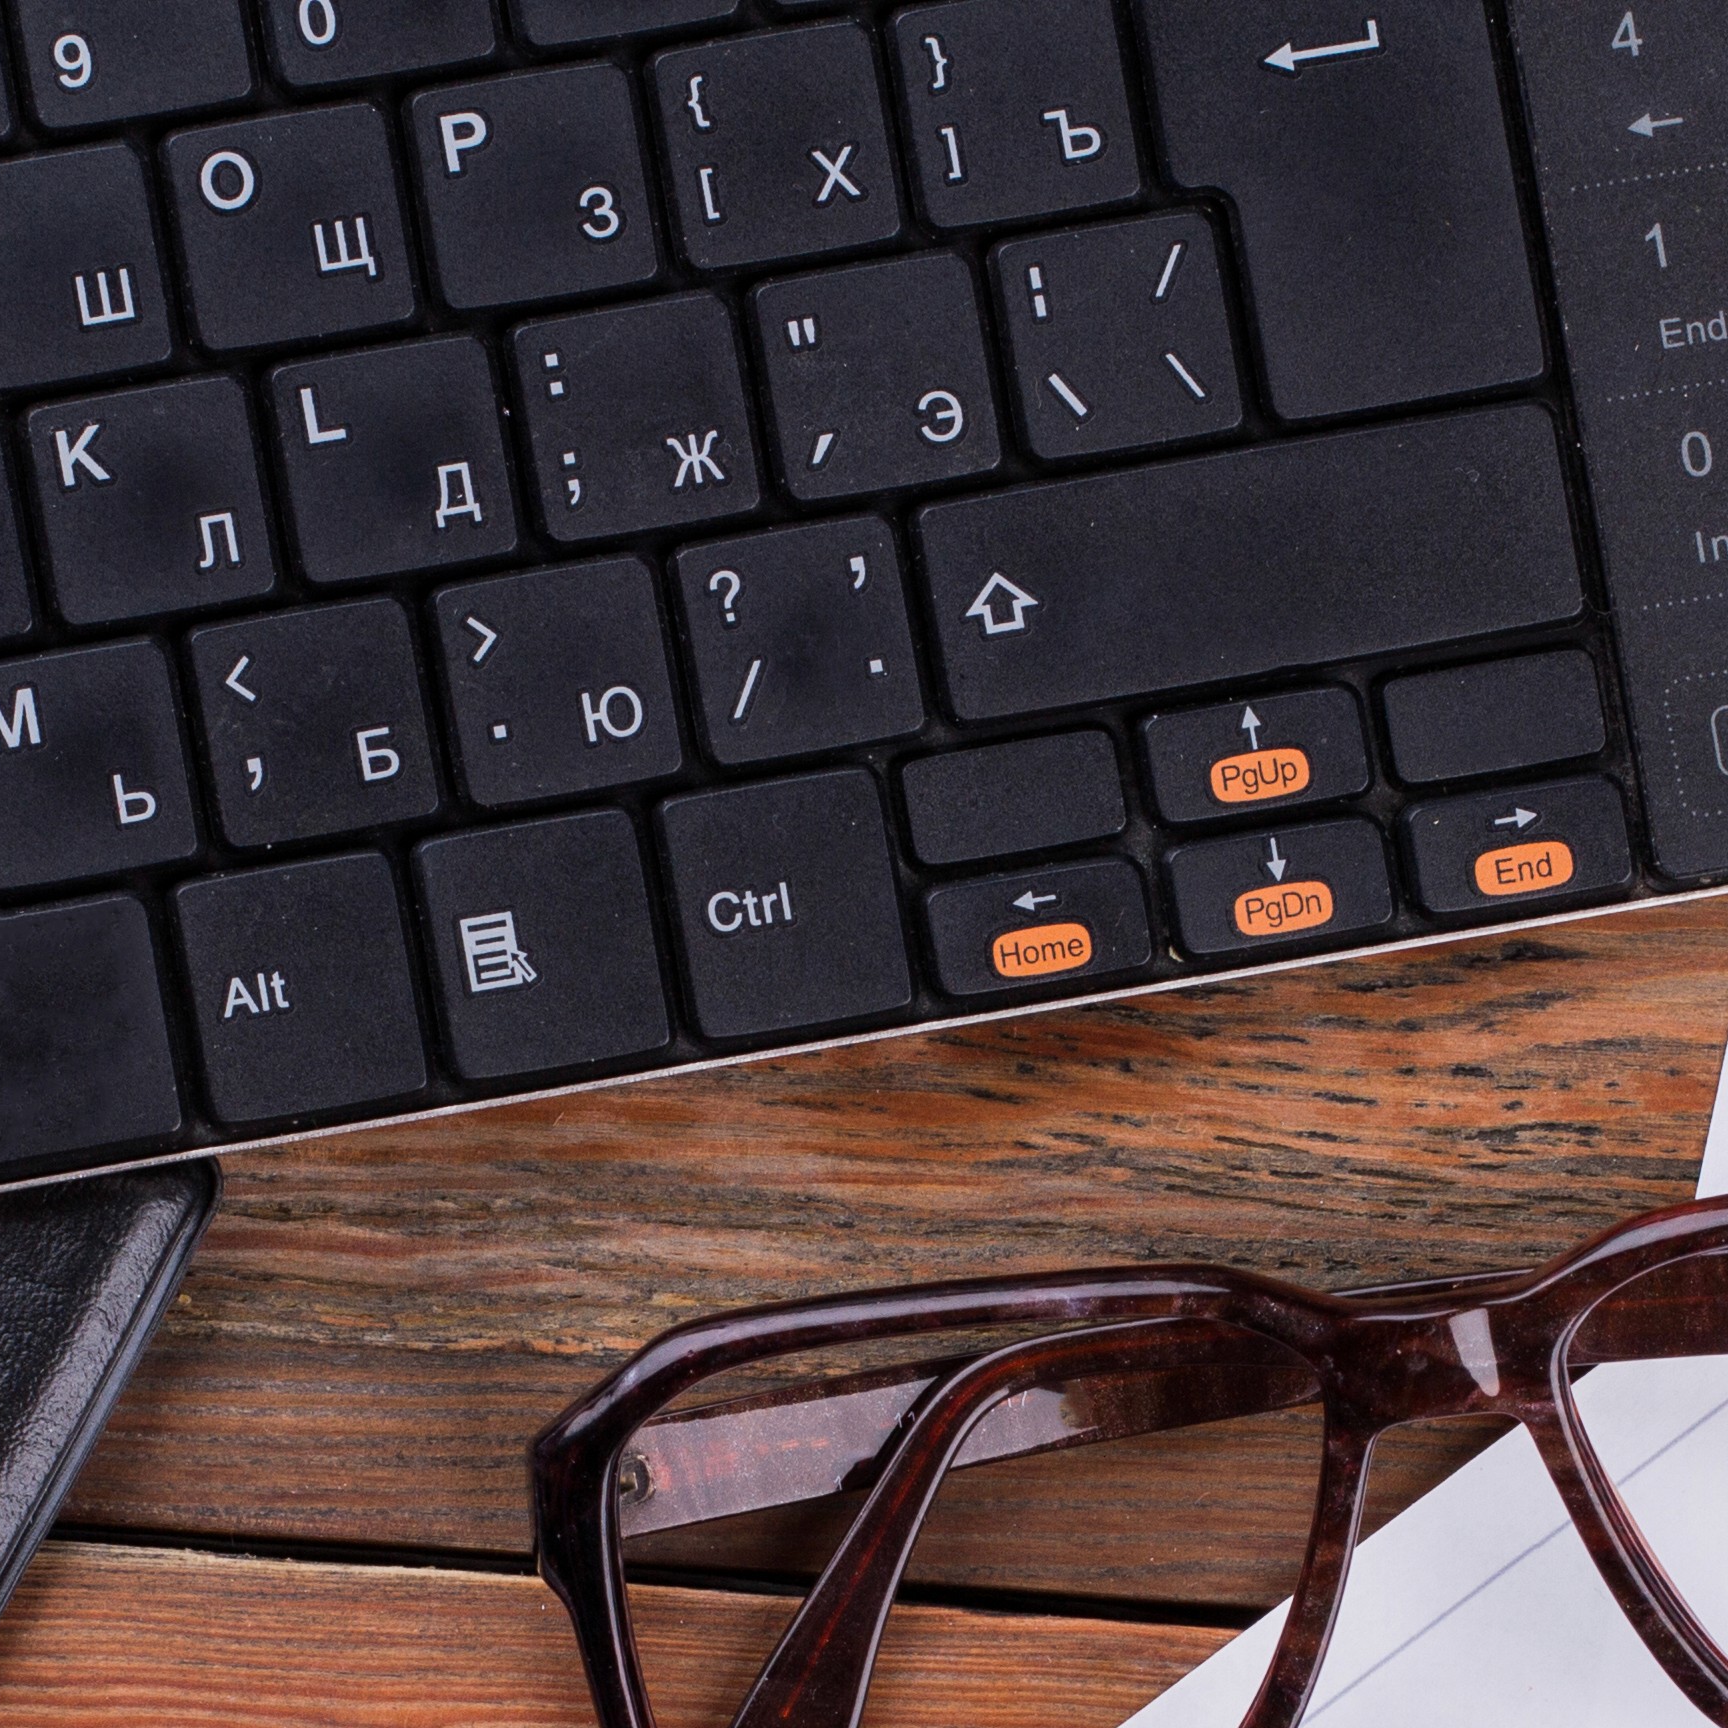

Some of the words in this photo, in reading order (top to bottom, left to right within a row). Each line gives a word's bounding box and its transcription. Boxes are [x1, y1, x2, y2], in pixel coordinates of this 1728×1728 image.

[1611, 10, 1643, 57] 4
[53, 34, 92, 88] 9
[439, 112, 487, 173] P
[1043, 109, 1101, 160] Ъ
[313, 217, 377, 276] Щ
[75, 268, 135, 326] Ш
[1659, 310, 1728, 350] End
[300, 387, 347, 444] L
[918, 390, 964, 442] Э
[55, 424, 111, 487] K
[666, 429, 725, 488] Ж
[435, 461, 483, 528] Д
[199, 512, 240, 568] Л
[581, 686, 643, 742] Ю
[356, 726, 400, 782] Б
[1221, 757, 1299, 796] PgUp
[1493, 852, 1553, 885] End
[707, 881, 792, 932] Ctrl
[1244, 892, 1323, 928] PgDn
[999, 937, 1085, 967] Home
[223, 971, 290, 1019] Alt
